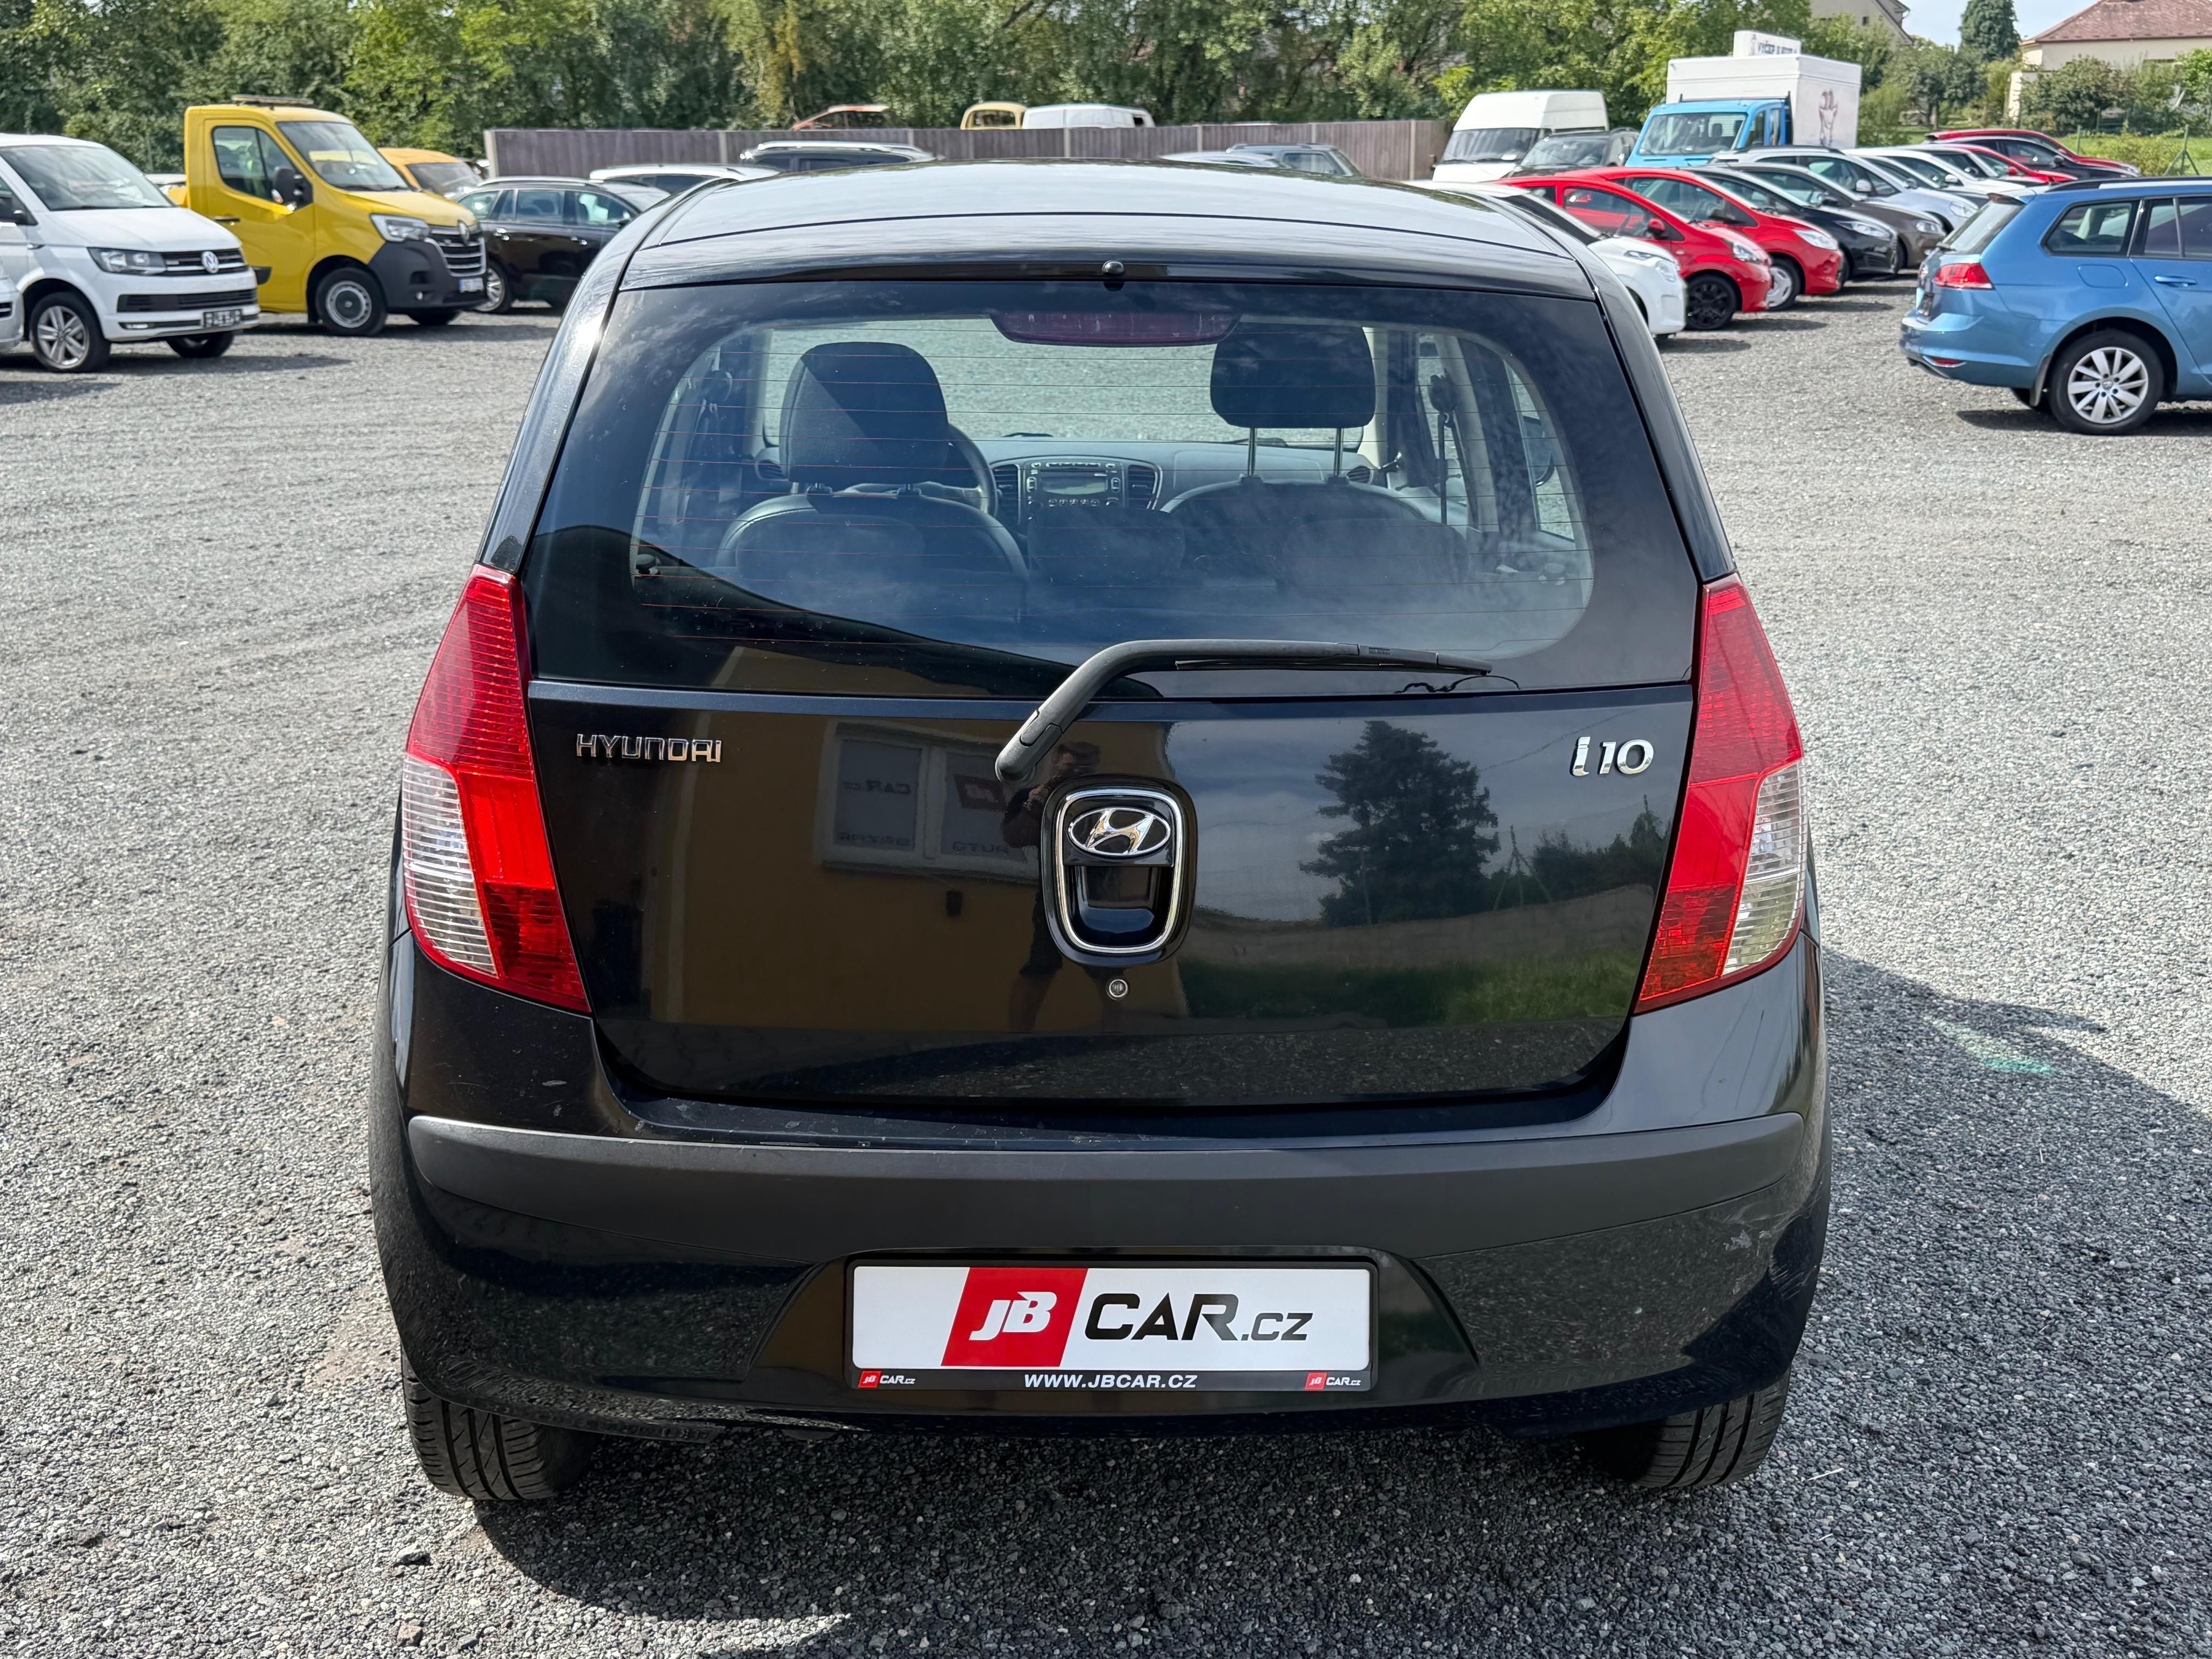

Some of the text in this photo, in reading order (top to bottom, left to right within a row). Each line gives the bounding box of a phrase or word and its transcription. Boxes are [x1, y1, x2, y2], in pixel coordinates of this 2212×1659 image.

[576, 733, 723, 763] HYUNDAI
[969, 1291, 1057, 1340] JB
[1024, 1374, 1198, 1388] WWW.JBCAR.CZ
